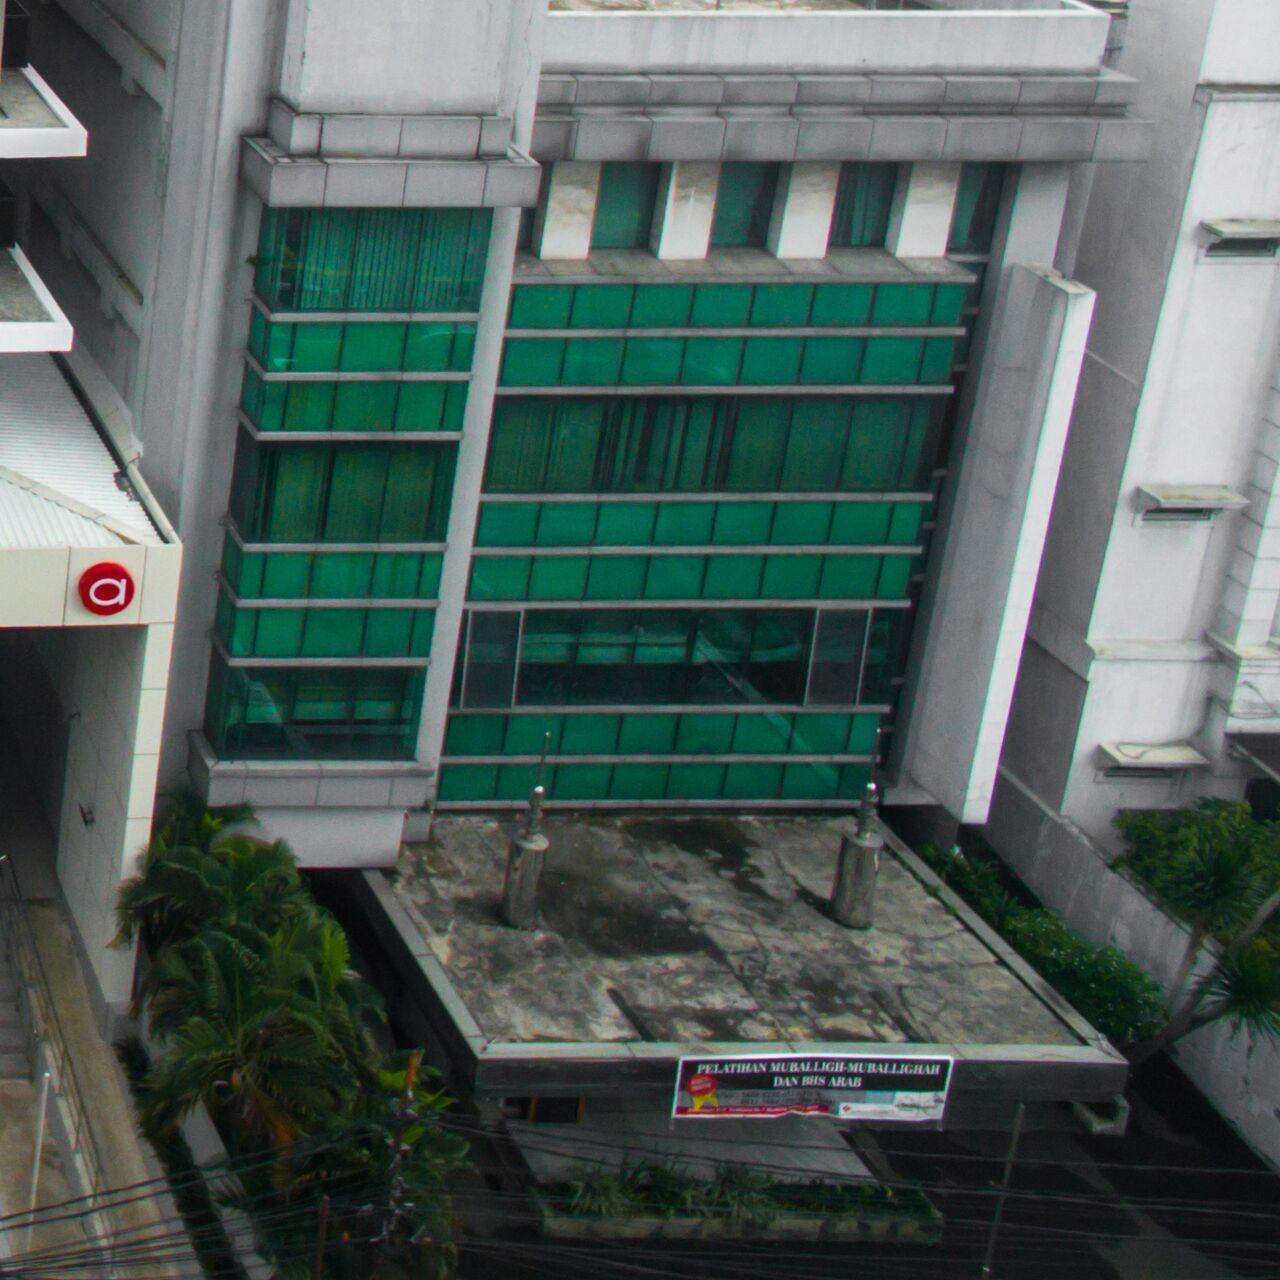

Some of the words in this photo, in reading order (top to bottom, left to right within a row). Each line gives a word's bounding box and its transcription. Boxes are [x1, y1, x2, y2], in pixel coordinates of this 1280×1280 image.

[697, 1062, 767, 1074] PELATIHAN
[773, 1075, 799, 1087] DAN
[828, 1076, 863, 1088] ARAB
